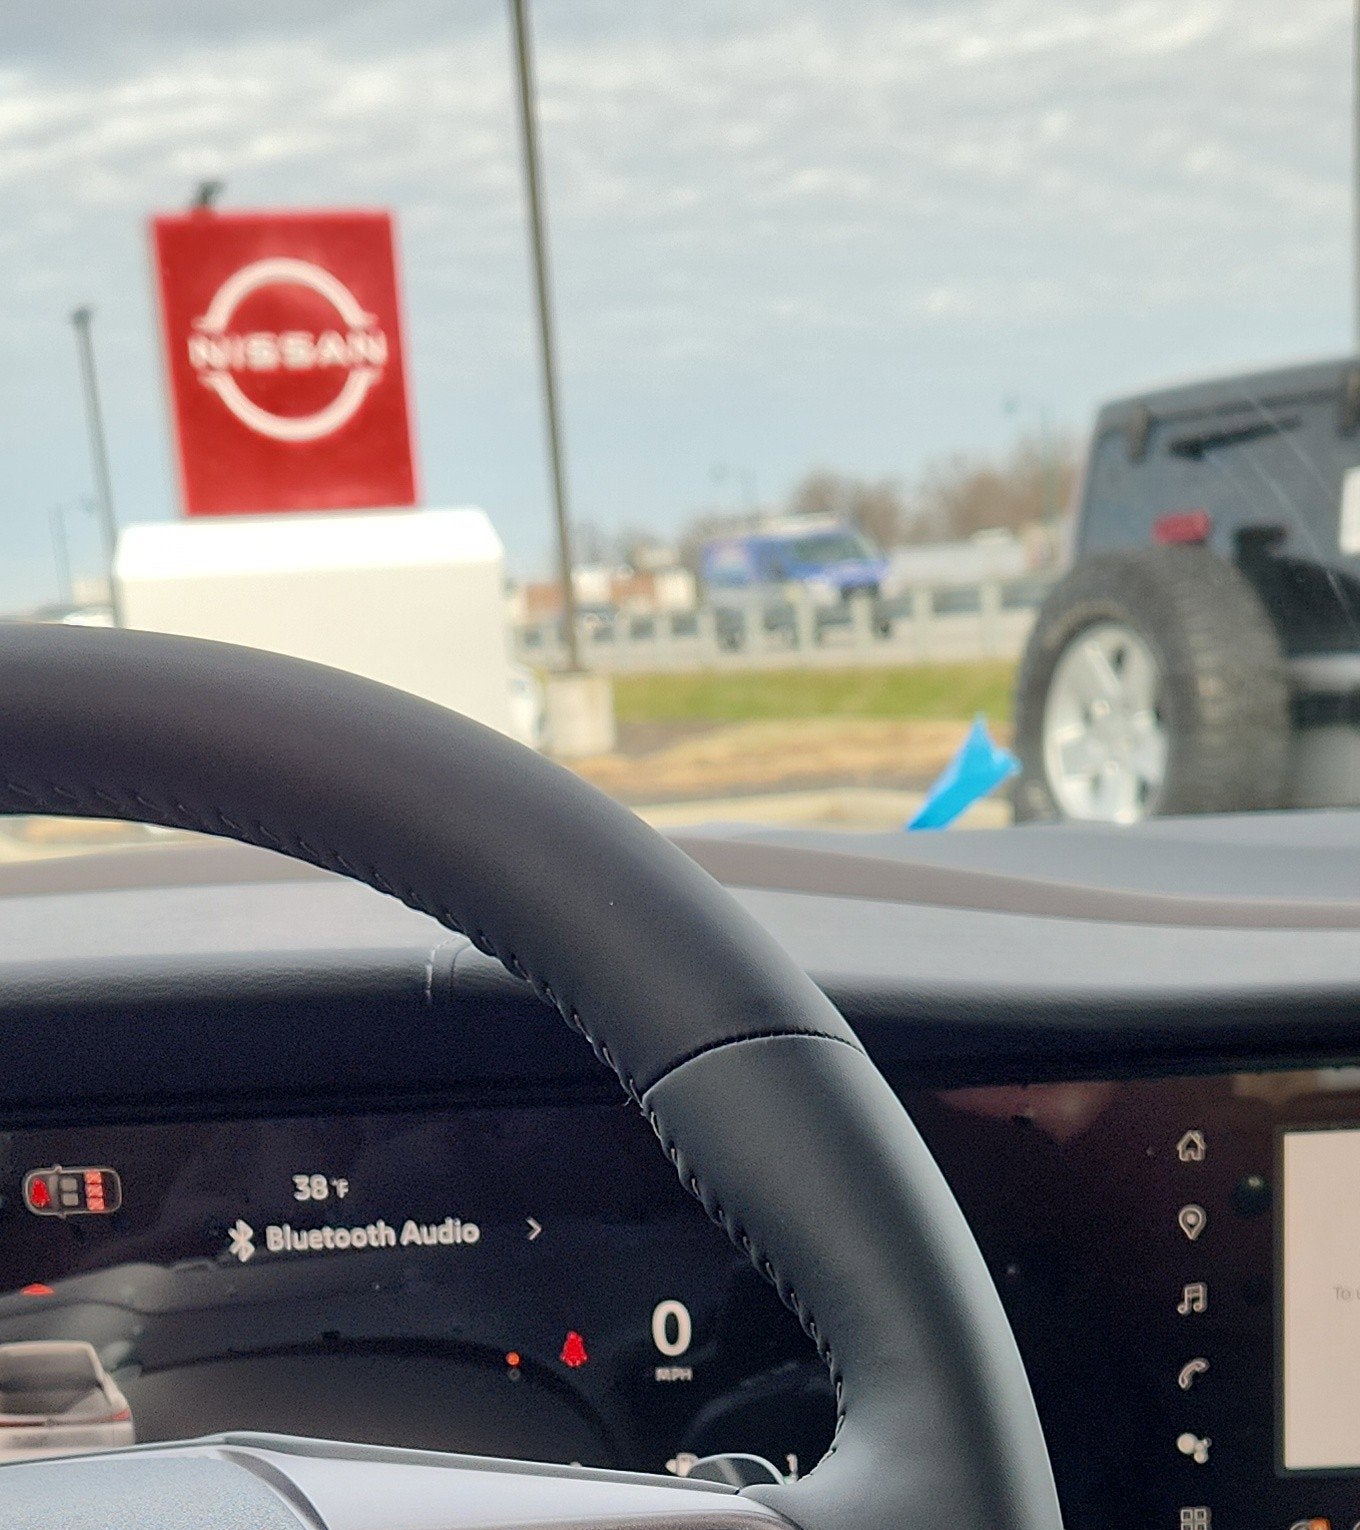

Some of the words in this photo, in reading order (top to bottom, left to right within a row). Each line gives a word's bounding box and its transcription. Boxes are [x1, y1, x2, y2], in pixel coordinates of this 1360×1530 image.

[187, 328, 388, 372] NISSAN
[265, 1218, 397, 1251] Bluetooth
[398, 1216, 481, 1247] Audio
[1333, 1285, 1351, 1301] To
[652, 1299, 692, 1356] 0
[654, 1366, 693, 1382] MPH
